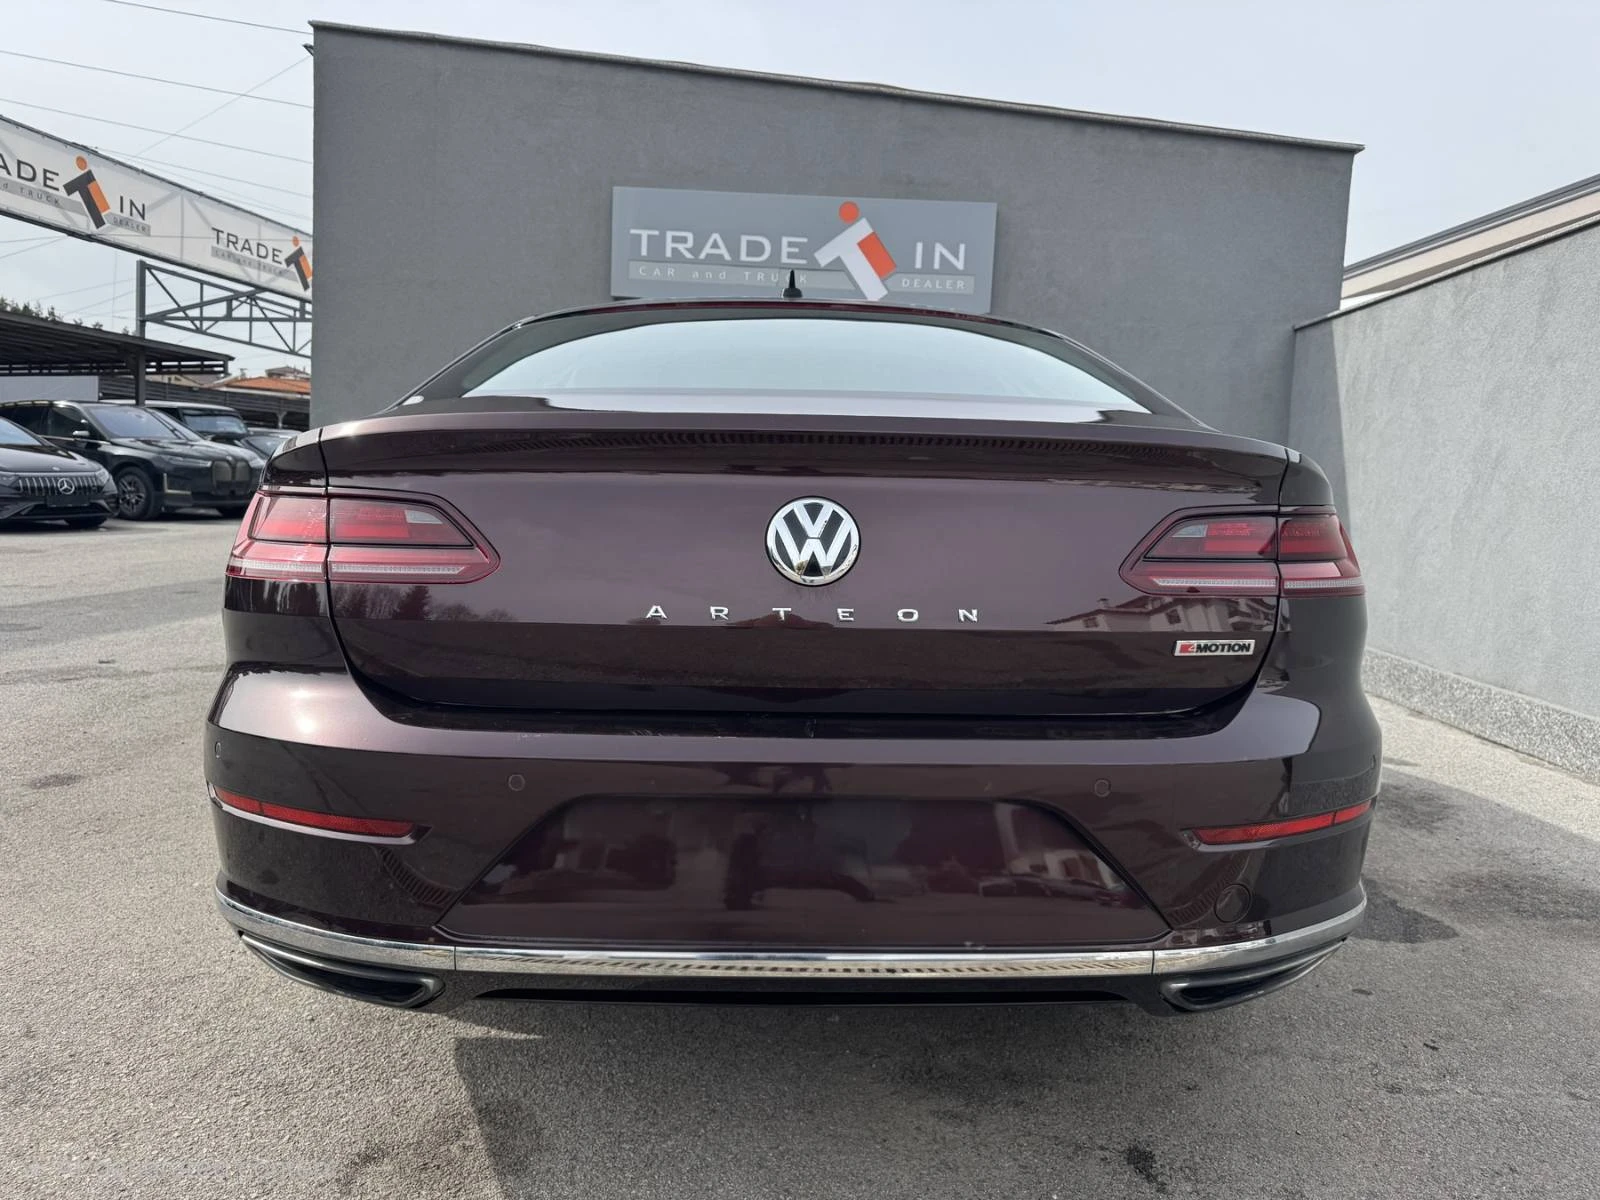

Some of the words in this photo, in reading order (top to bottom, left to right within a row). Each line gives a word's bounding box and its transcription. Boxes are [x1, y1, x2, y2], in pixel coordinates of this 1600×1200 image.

[120, 195, 146, 221] IN
[211, 227, 283, 264] TRADE
[629, 228, 808, 265] TRADE
[914, 241, 966, 271] IN
[639, 266, 676, 278] CAR
[692, 269, 727, 280] and
[902, 278, 966, 290] DEALER
[645, 605, 979, 622] ARTEON
